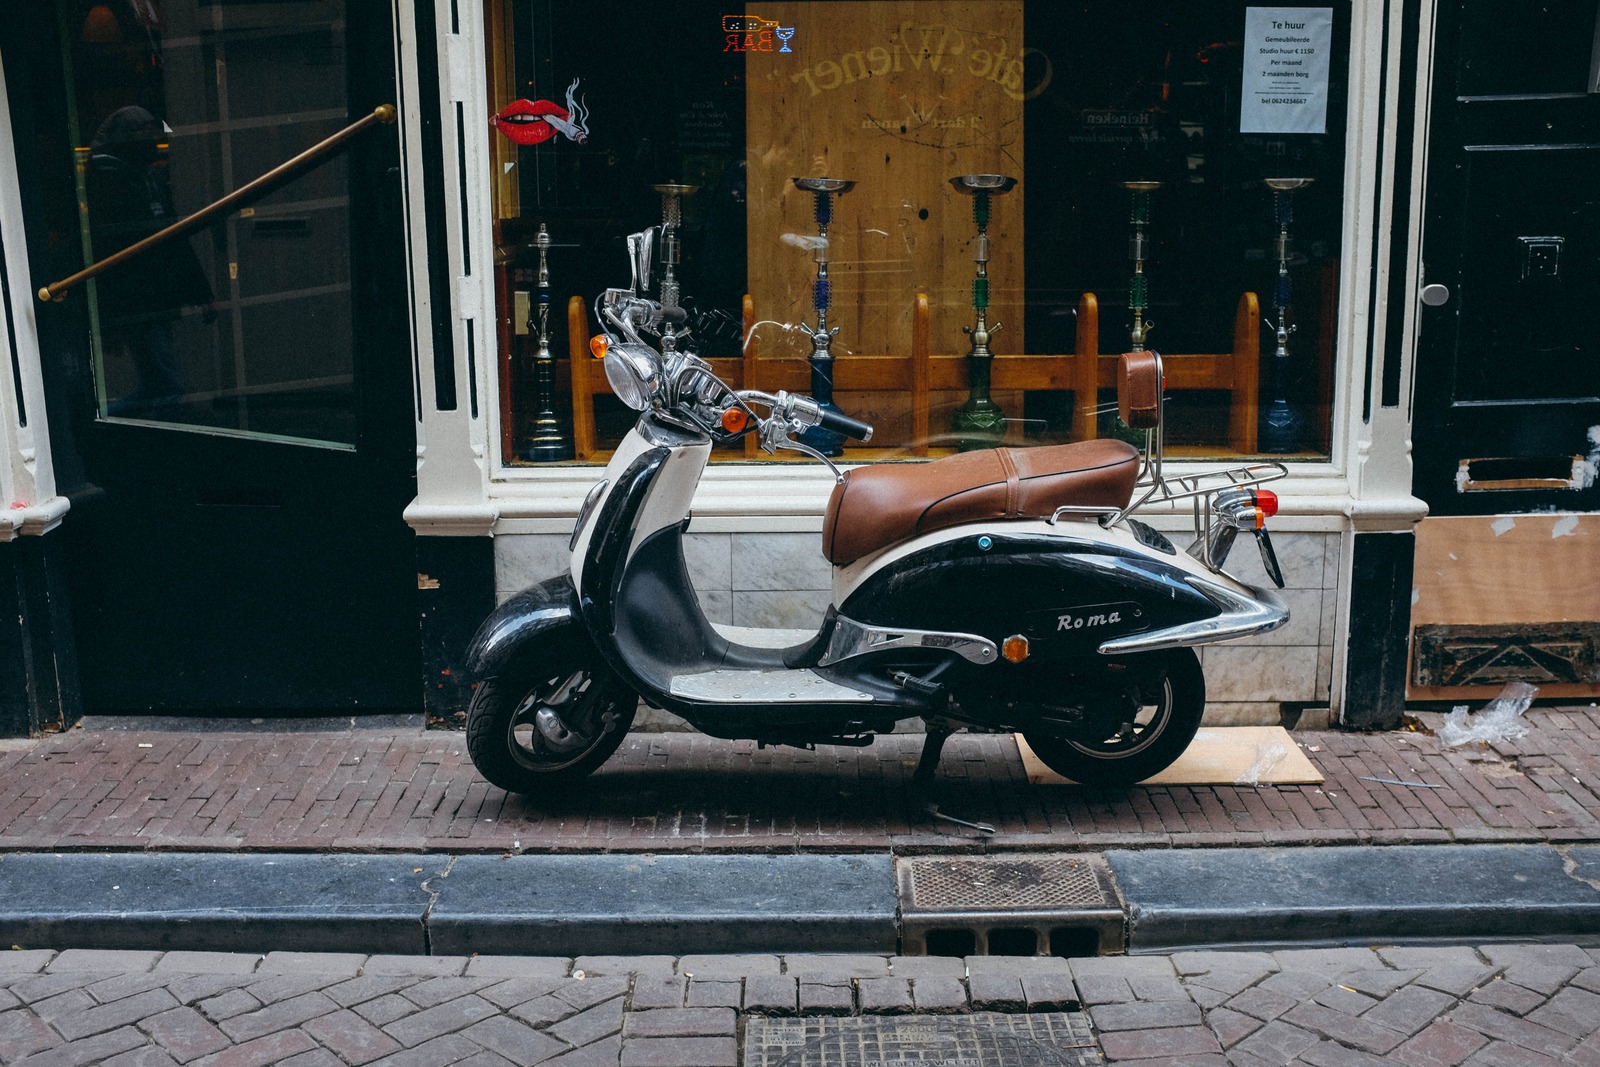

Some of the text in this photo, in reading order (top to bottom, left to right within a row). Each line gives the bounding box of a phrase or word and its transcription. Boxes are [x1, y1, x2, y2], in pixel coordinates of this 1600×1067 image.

[1272, 21, 1305, 29] Te huur
[1295, 71, 1310, 79] borg
[1057, 612, 1122, 631] Roma
